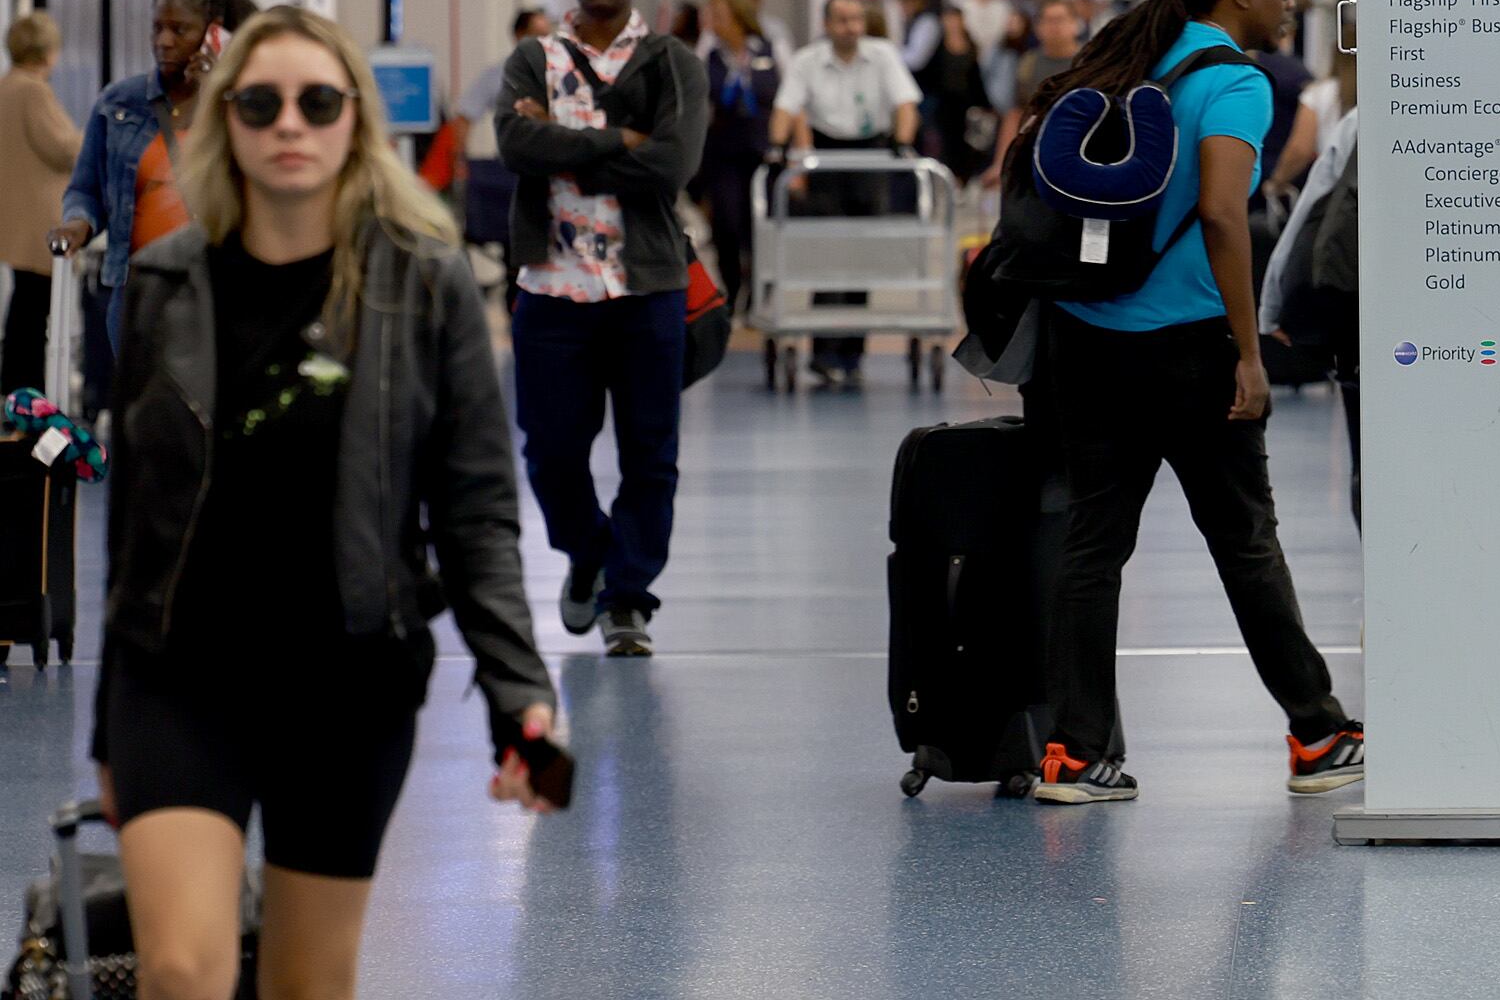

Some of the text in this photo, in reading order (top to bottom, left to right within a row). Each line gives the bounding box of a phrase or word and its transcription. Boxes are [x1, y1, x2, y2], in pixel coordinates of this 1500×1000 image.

[1391, 46, 1425, 61] First
[1391, 73, 1460, 88] Business
[1391, 100, 1467, 115] Premium
[1426, 220, 1500, 235] Platinum
[1426, 247, 1500, 262] Platinum
[1426, 274, 1464, 289] Gold
[1423, 346, 1475, 362] Priority
